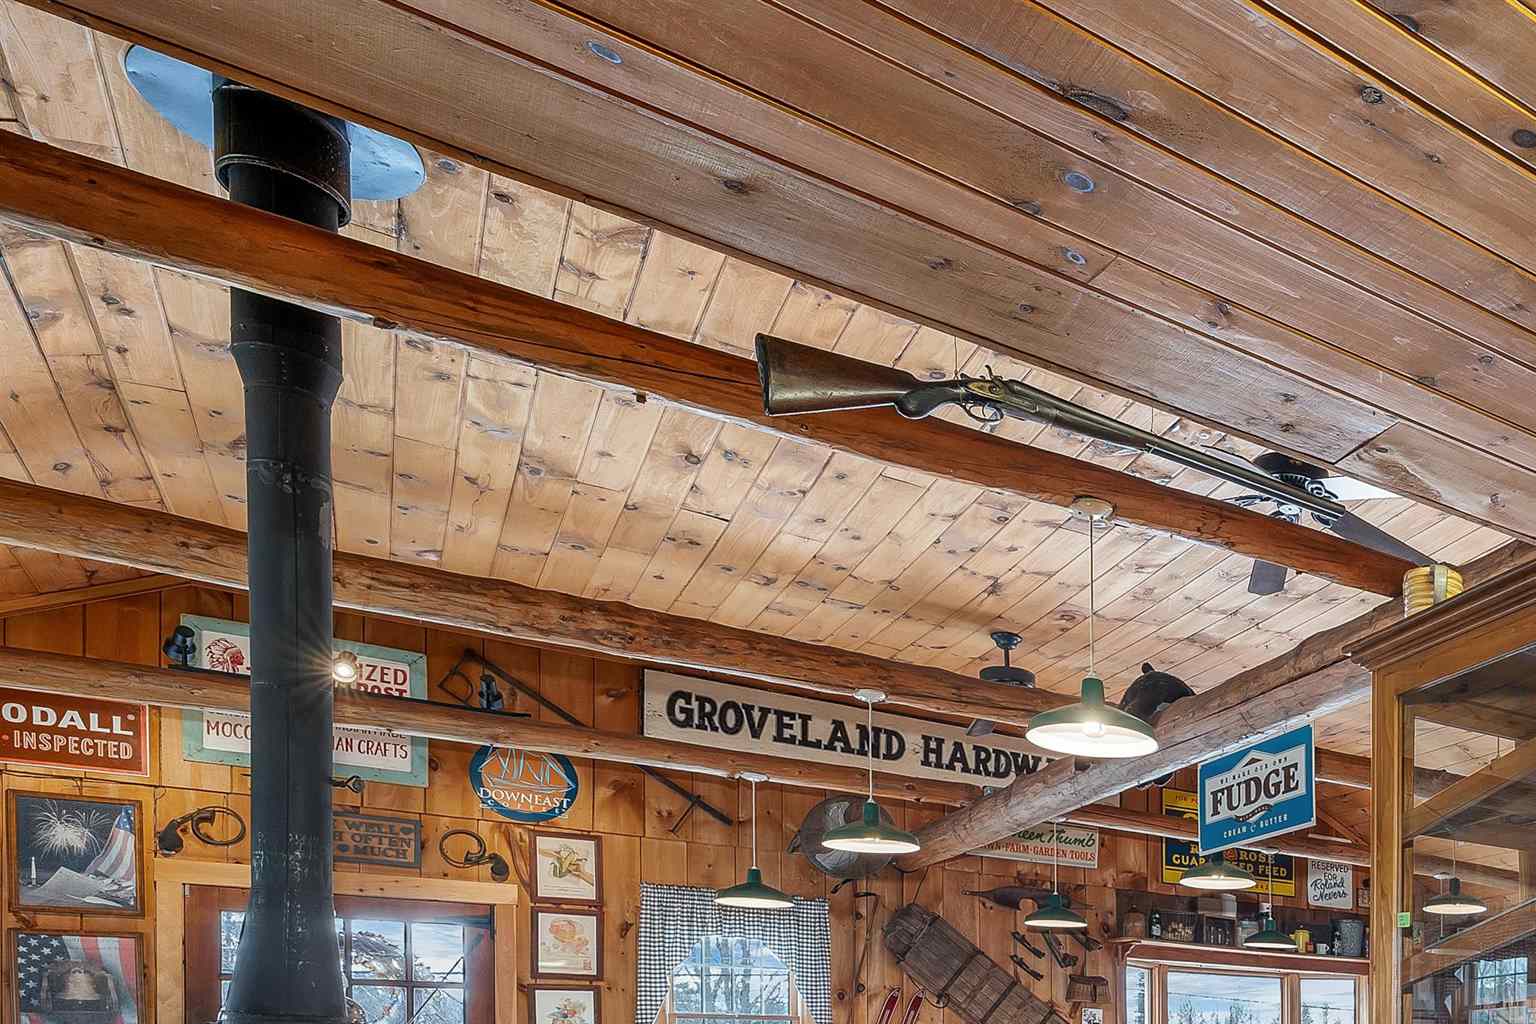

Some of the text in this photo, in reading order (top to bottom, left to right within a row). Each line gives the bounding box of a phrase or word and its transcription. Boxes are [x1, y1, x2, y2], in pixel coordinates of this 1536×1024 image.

[357, 662, 408, 686] IZED
[1, 702, 134, 736] ODALL
[665, 690, 906, 761] GROVELAND
[13, 730, 133, 760] INSPECTED
[206, 719, 408, 759] MOCC IAN CRAFTS
[1254, 763, 1269, 773] OUR
[1272, 756, 1288, 766] OWN
[479, 787, 571, 809] DOWNEAST
[1210, 762, 1299, 817] FUDGE
[1223, 825, 1247, 839] CREAM
[1260, 814, 1288, 828] BUTTER
[351, 831, 414, 848] OFTEN
[1011, 829, 1096, 848] reen Thumb
[352, 846, 411, 861] MUCH
[1006, 842, 1029, 853] FARM
[1033, 846, 1068, 859] GARDEN
[1069, 850, 1096, 862] TOOLS
[1239, 850, 1276, 864] ROSE
[1259, 866, 1287, 877] FEED
[1311, 861, 1349, 873] RESERVED
[1324, 872, 1337, 881] FOR
[1310, 877, 1346, 891] Roland
